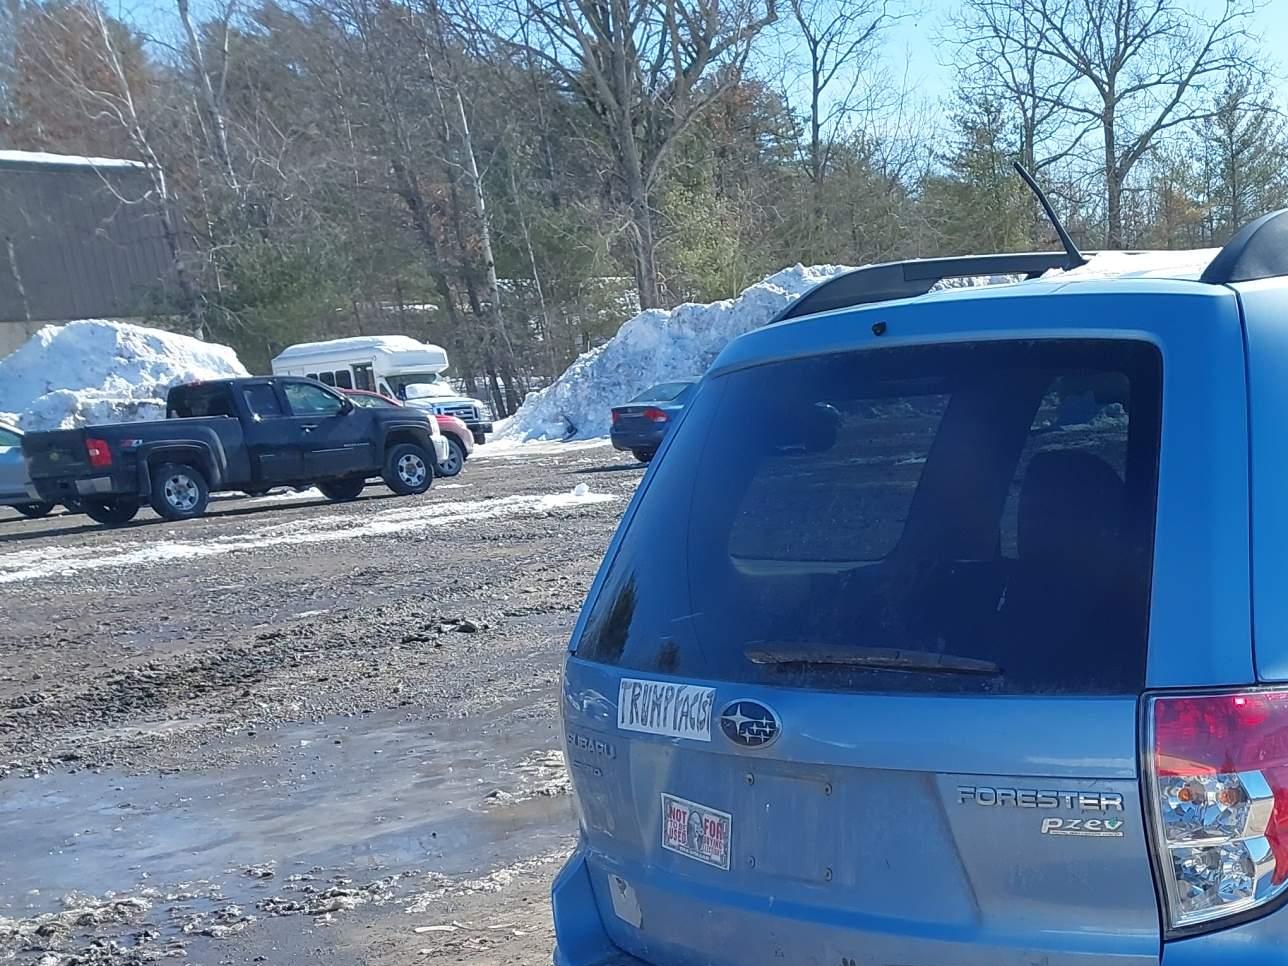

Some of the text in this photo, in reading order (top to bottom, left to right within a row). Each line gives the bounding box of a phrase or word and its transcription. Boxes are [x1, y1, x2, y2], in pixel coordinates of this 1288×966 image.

[568, 733, 617, 760] SUBARU
[957, 785, 1125, 812] FORESTER
[668, 806, 687, 824] NOT
[668, 828, 688, 844] USED
[704, 818, 724, 840] FOR
